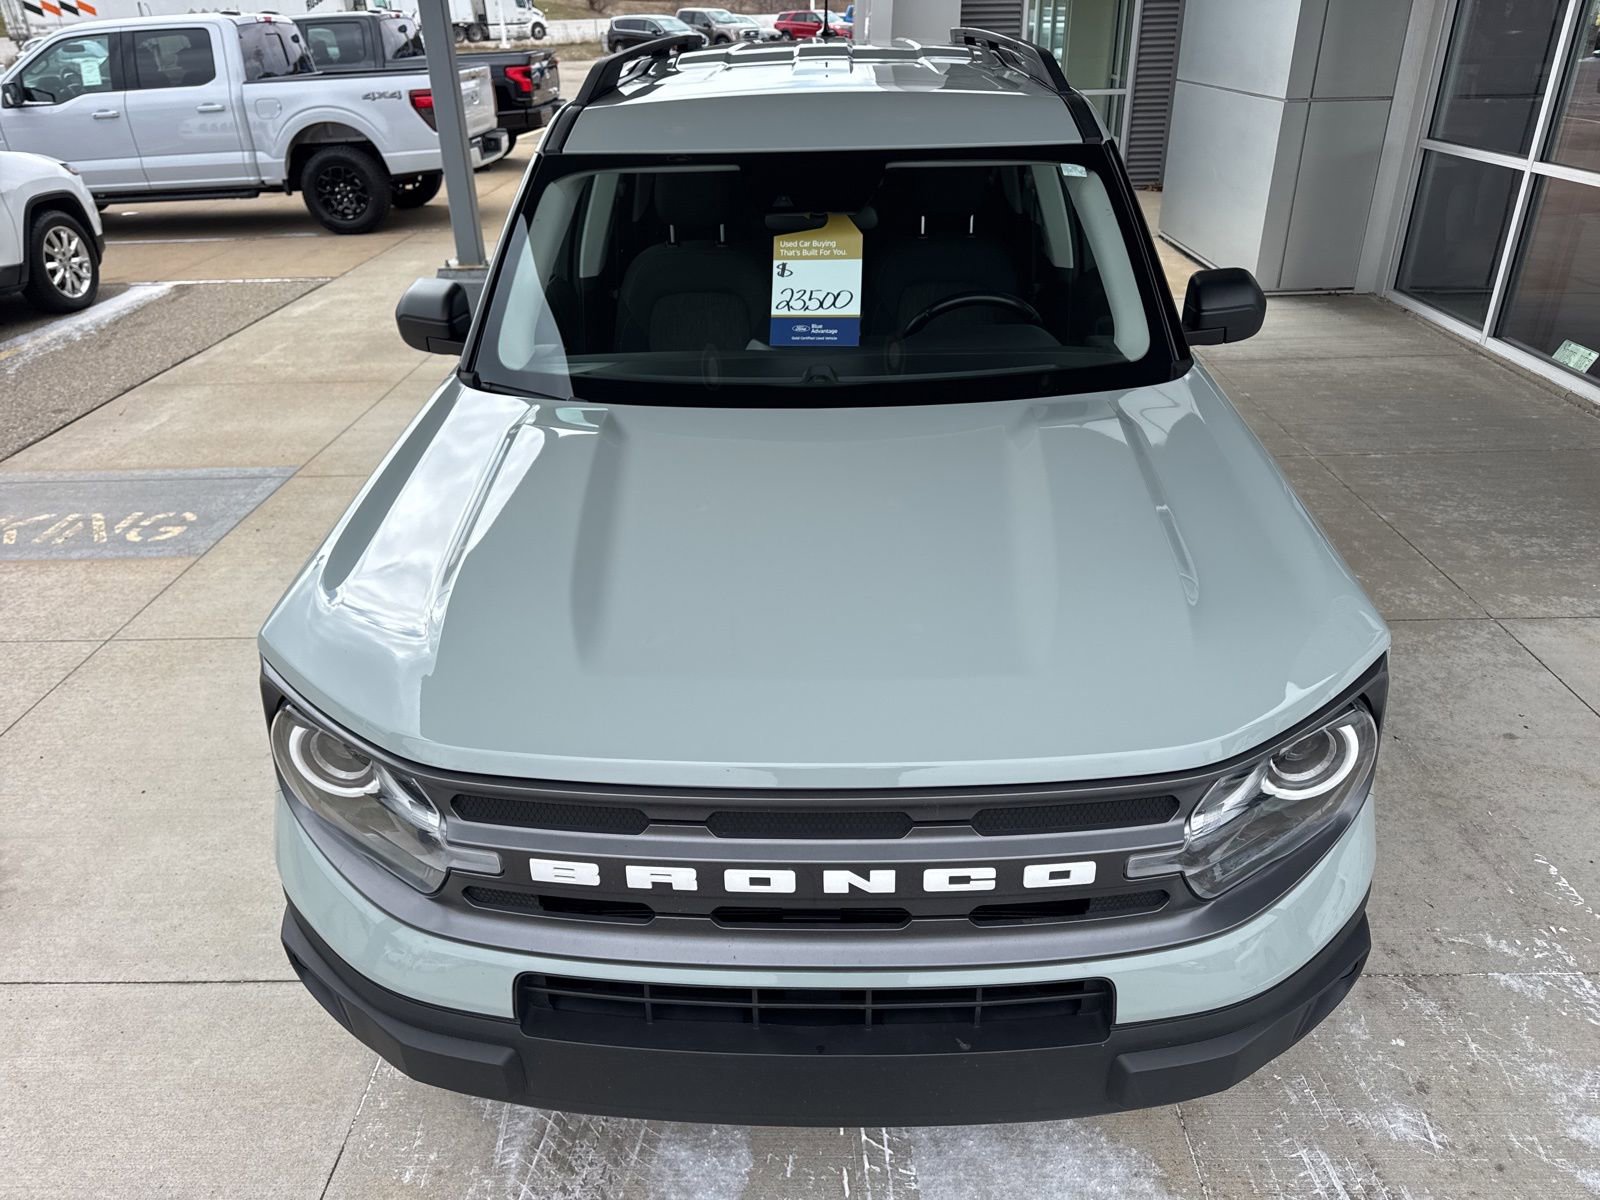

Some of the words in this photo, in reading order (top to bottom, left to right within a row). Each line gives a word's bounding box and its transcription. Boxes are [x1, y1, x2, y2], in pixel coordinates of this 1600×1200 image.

[780, 240, 798, 248] Used
[812, 240, 836, 249] Buying
[776, 262, 794, 278] $
[529, 857, 1097, 894] BRONCO
